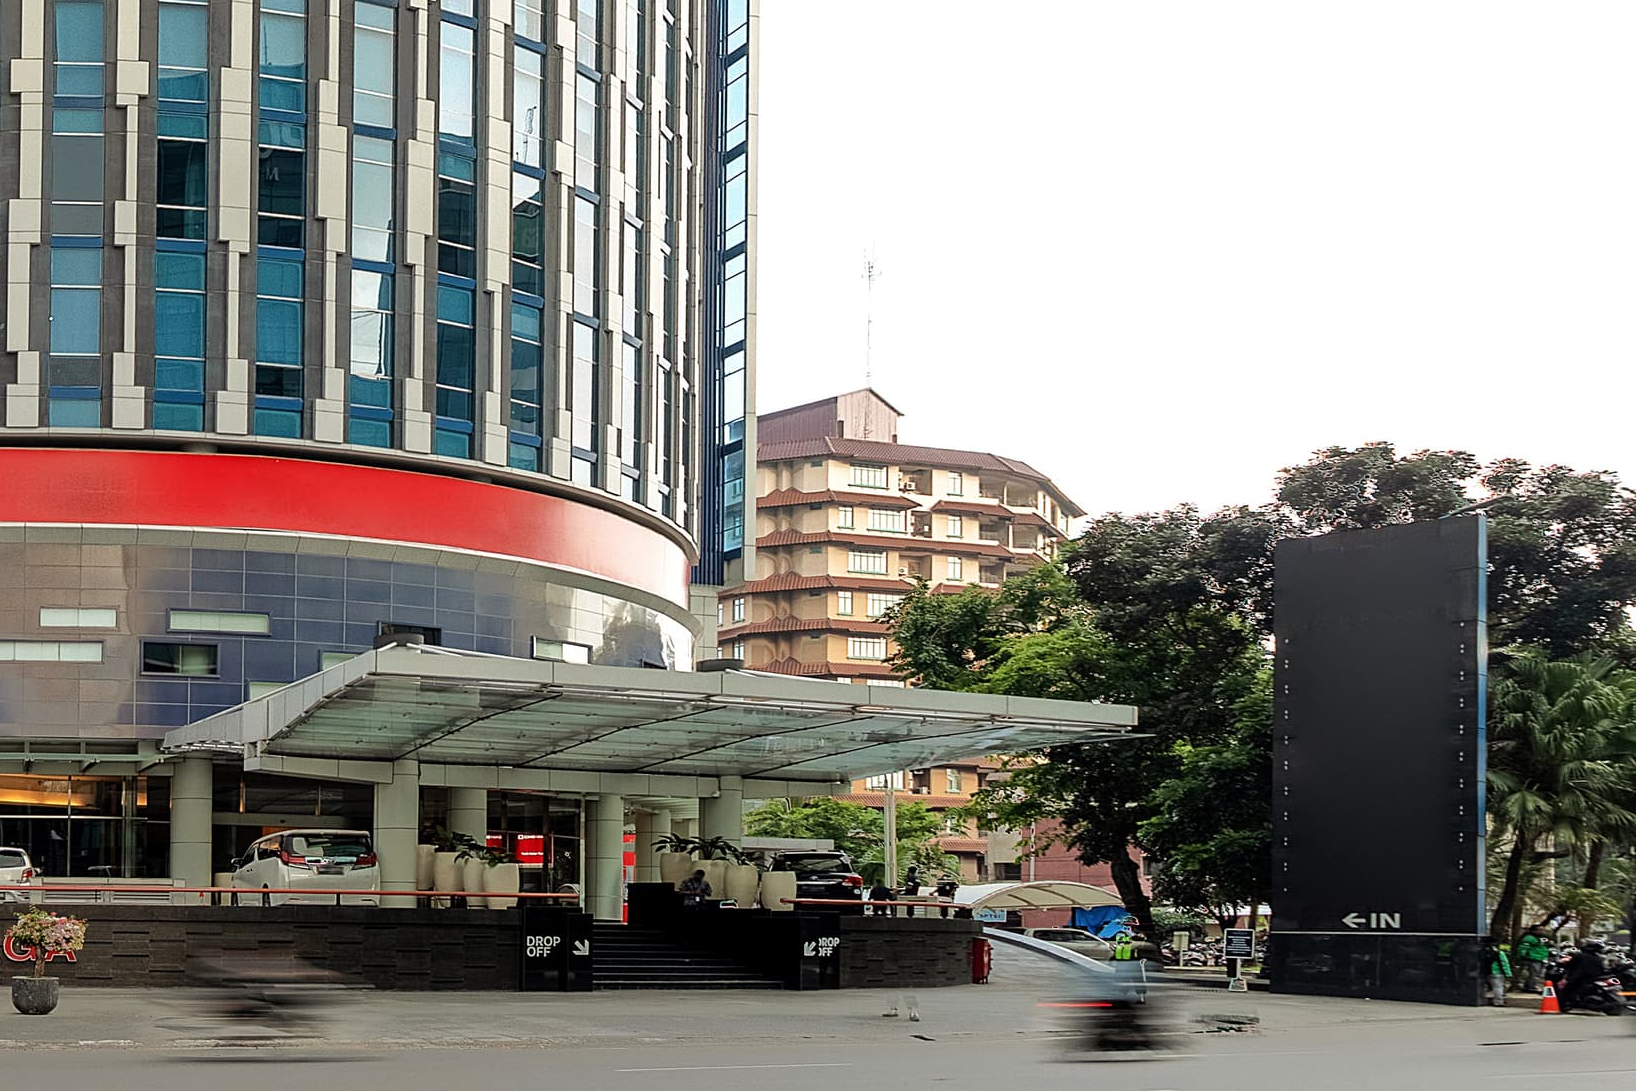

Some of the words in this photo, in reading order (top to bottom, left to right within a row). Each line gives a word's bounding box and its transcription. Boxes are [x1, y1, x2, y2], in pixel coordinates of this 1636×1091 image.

[1370, 912, 1401, 929] IN
[526, 935, 561, 947] DROP
[526, 946, 551, 957] OFF
